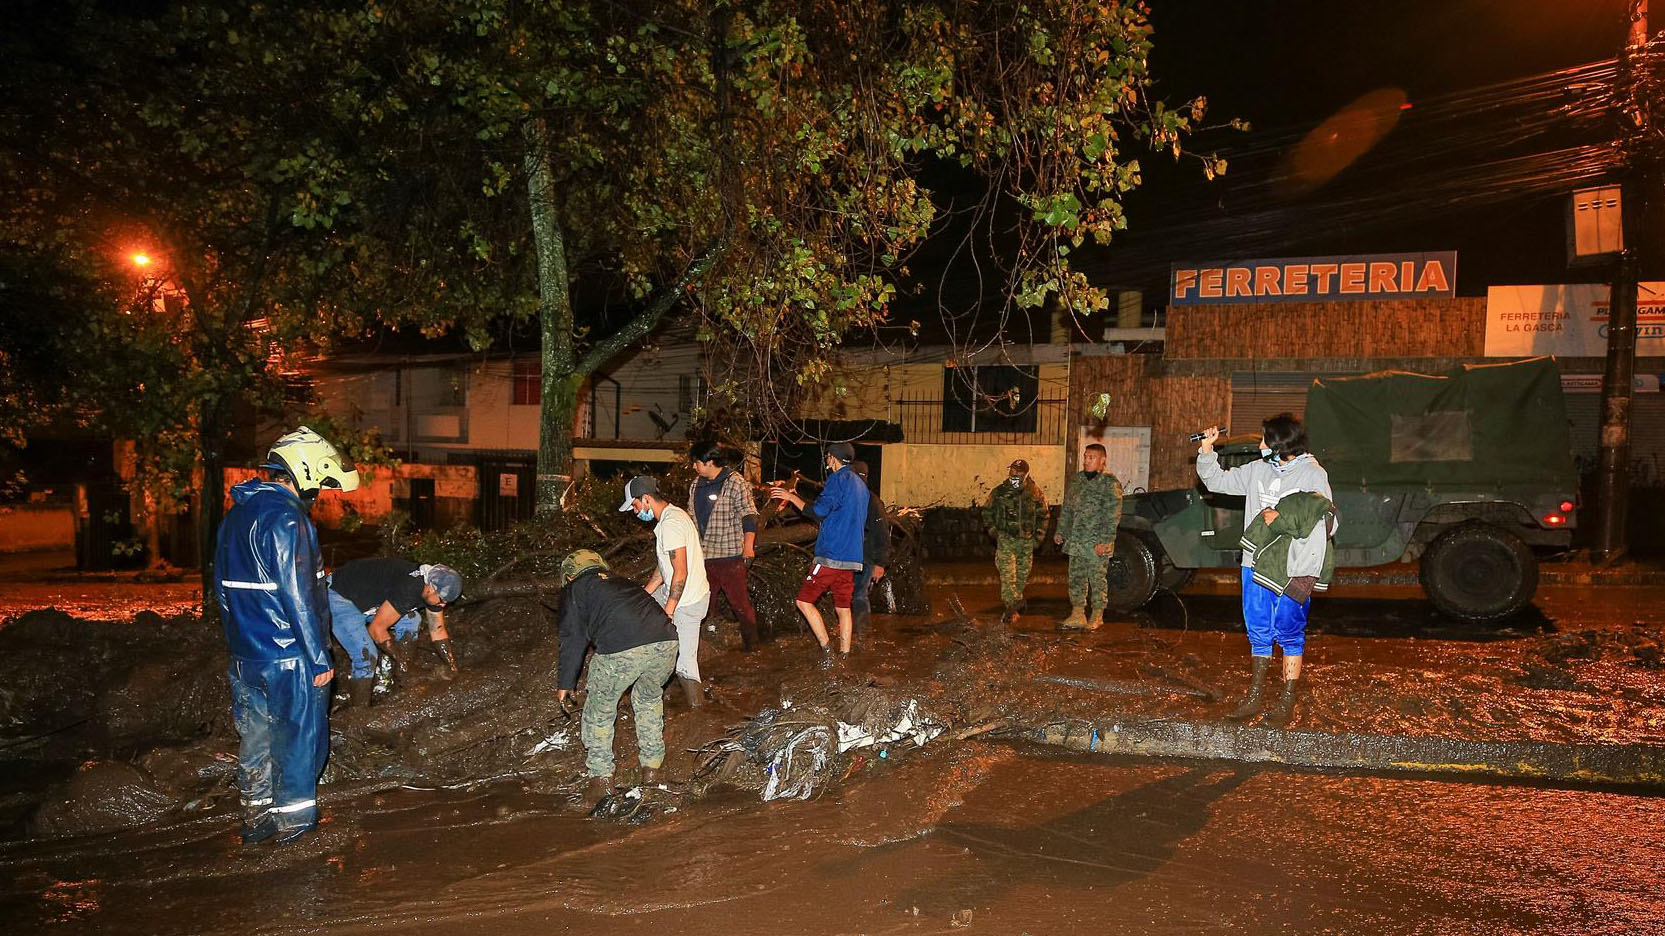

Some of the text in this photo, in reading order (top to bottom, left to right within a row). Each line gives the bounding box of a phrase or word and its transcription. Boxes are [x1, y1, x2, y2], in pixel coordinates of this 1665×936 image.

[1175, 260, 1449, 298] FERRETERIA
[1501, 312, 1571, 321] FERRETERIA
[1506, 323, 1563, 332] LA GASCA
[505, 477, 512, 486] E
